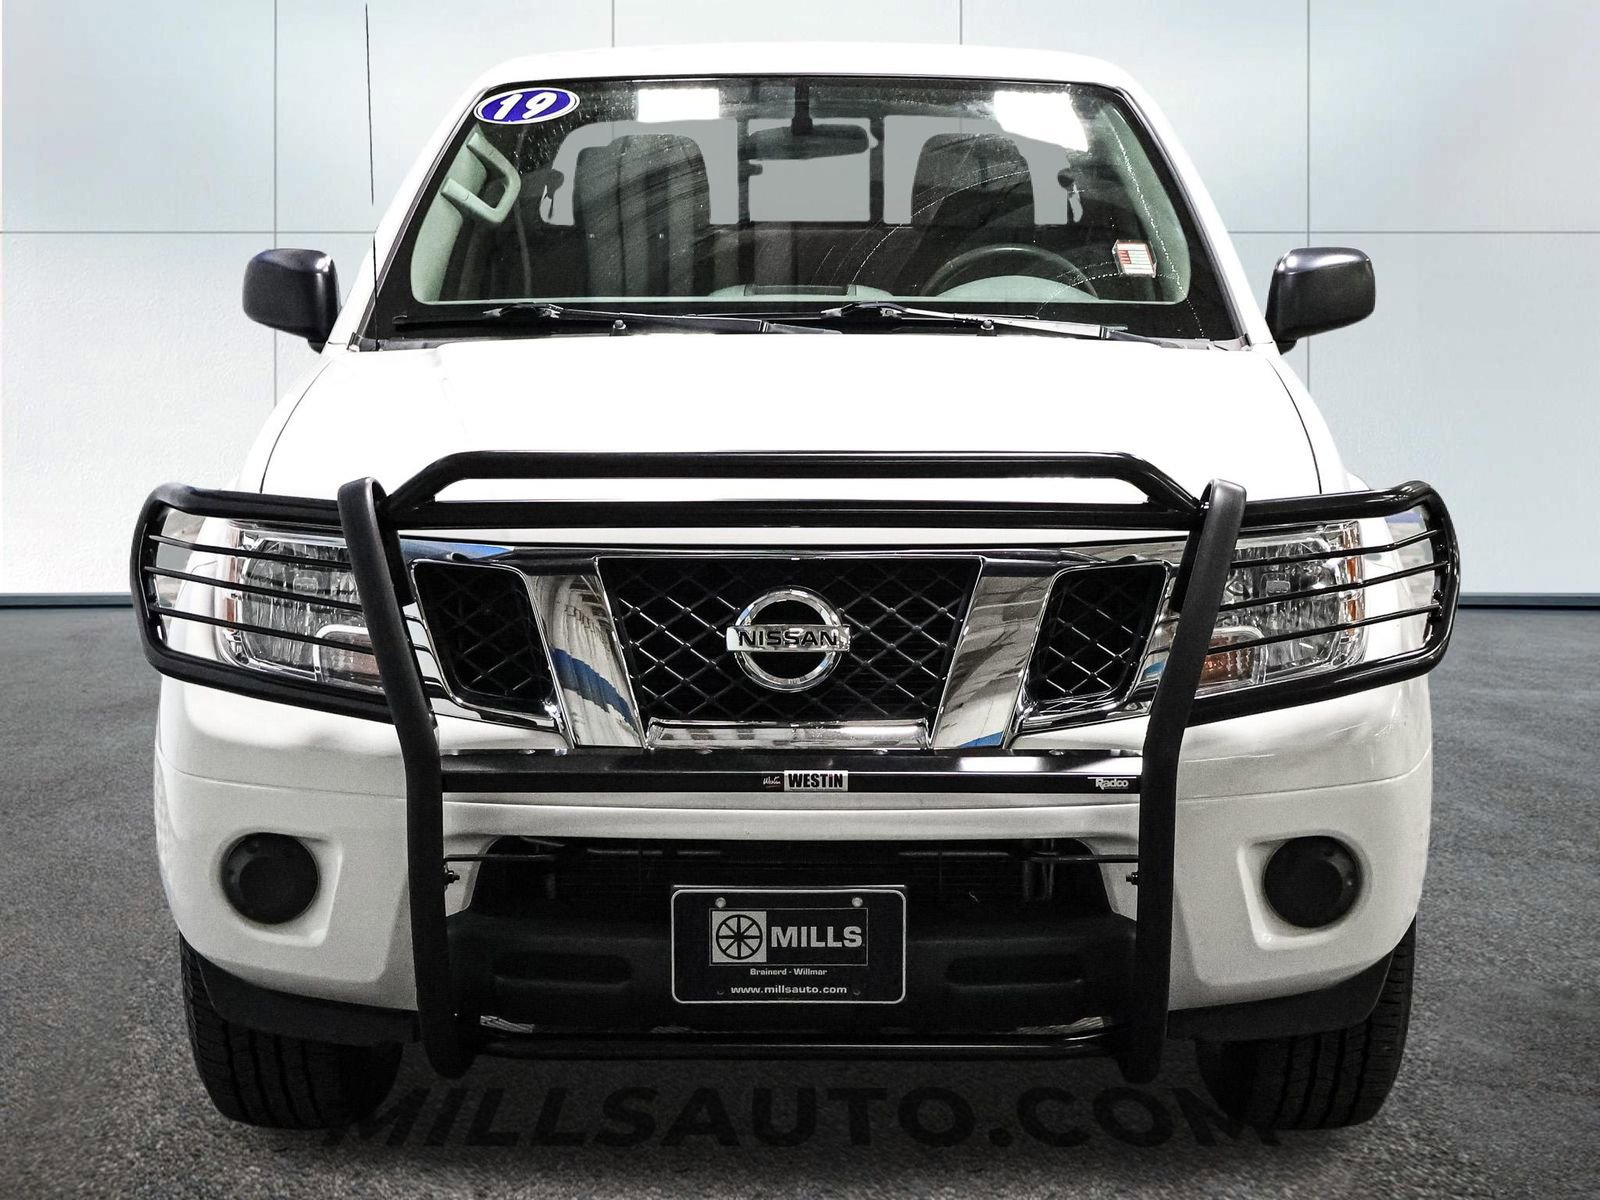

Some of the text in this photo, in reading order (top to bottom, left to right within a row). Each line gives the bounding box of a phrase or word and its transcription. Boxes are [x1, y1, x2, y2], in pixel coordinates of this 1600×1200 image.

[493, 91, 558, 120] 19
[738, 630, 838, 647] NISSAN
[788, 773, 843, 788] WESTIN
[770, 926, 863, 948] MILLS
[750, 968, 787, 976] Brainerd
[793, 968, 828, 976] Willmar
[730, 984, 848, 994] www.millsauto.com
